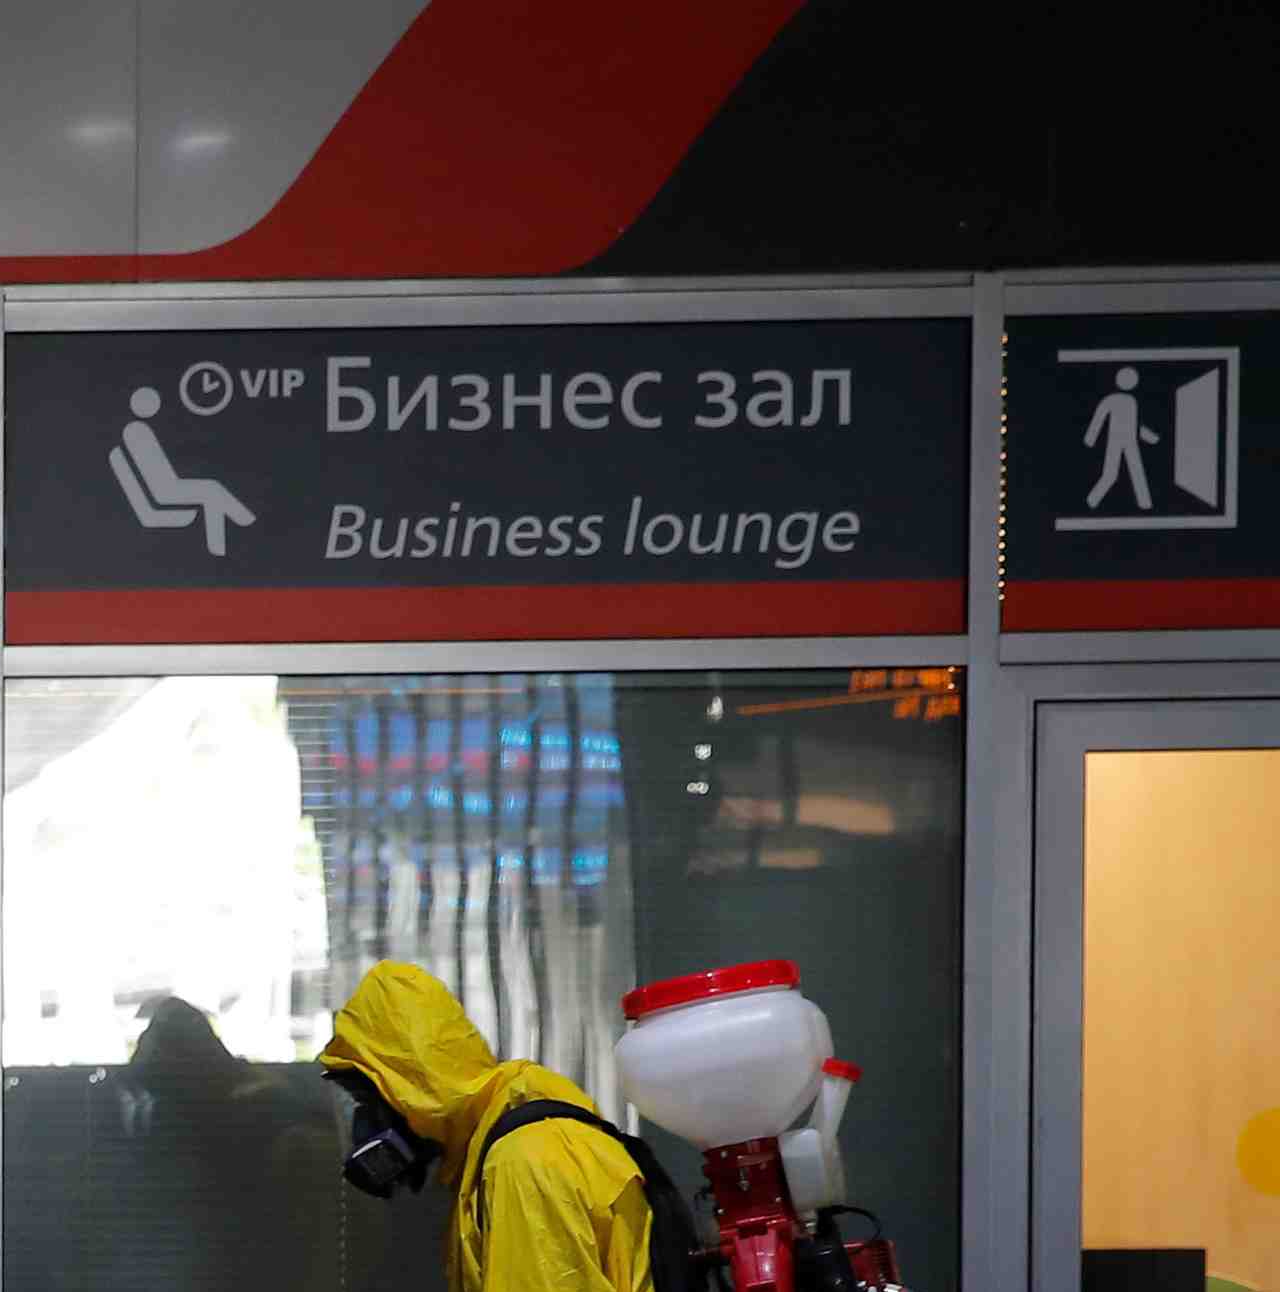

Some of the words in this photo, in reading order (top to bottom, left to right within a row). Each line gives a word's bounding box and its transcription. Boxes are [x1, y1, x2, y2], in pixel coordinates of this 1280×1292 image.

[240, 368, 306, 398] VIP
[325, 356, 664, 433] Бизнес
[694, 368, 853, 429] зал
[325, 501, 605, 560] Business
[623, 495, 862, 570] lounge
